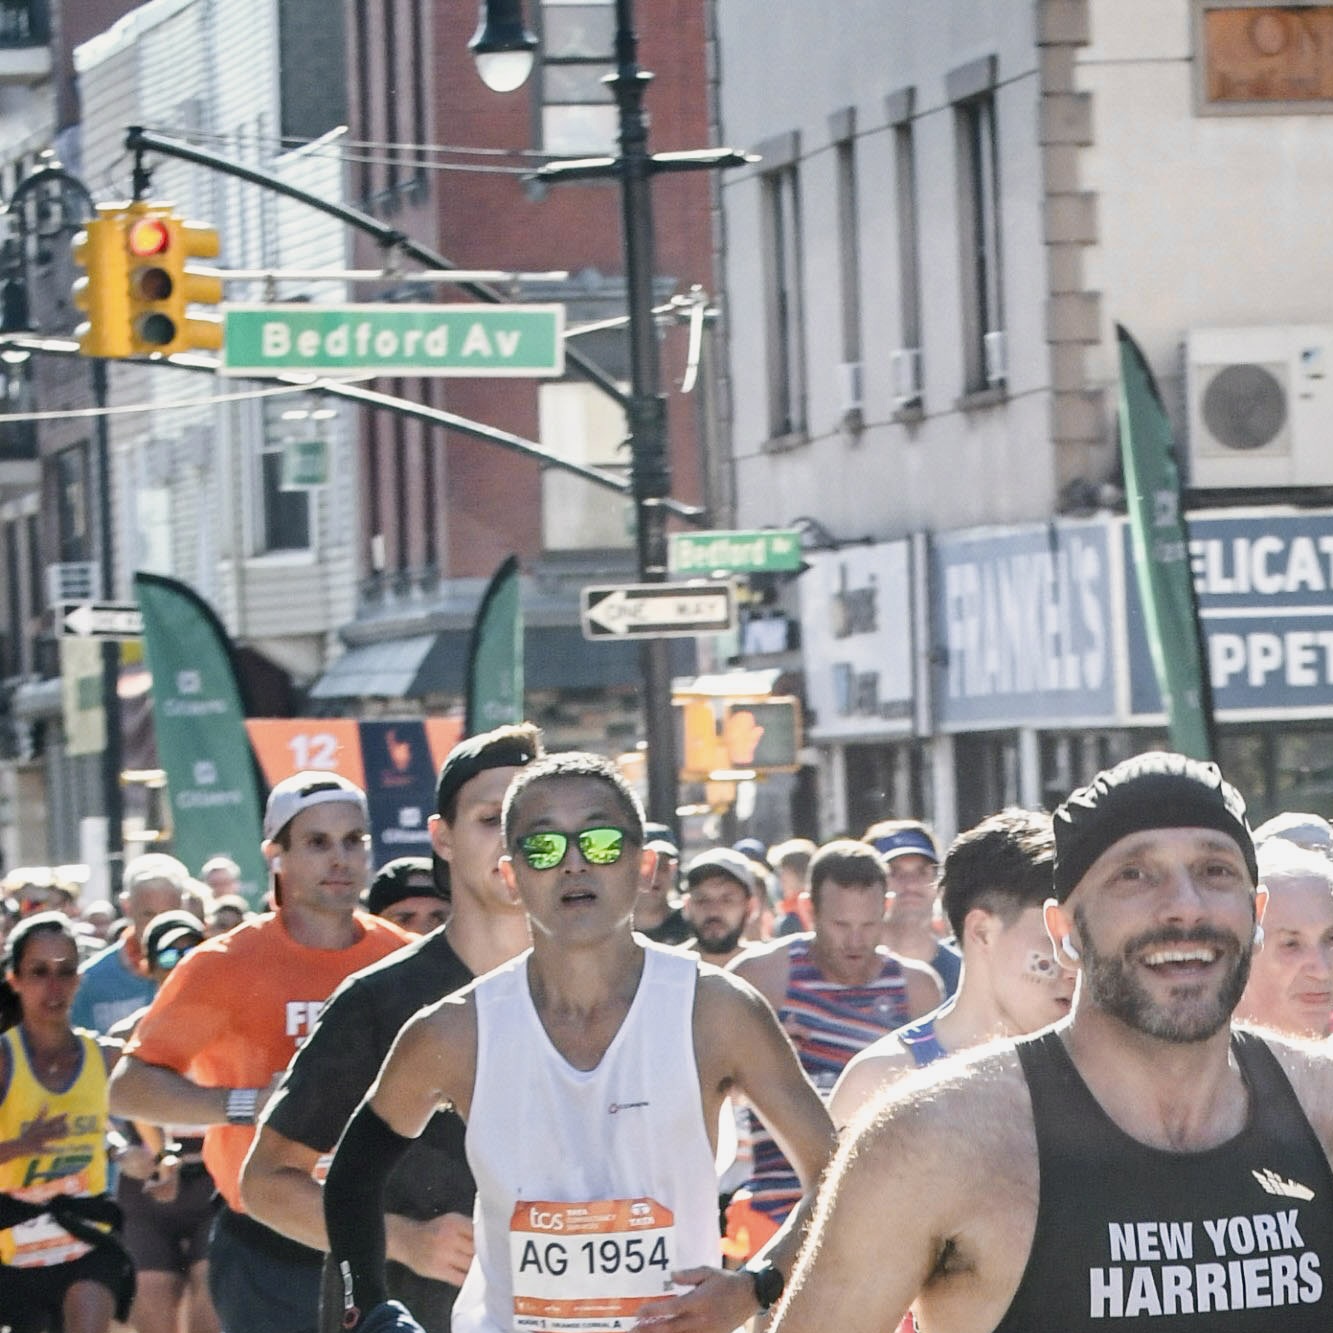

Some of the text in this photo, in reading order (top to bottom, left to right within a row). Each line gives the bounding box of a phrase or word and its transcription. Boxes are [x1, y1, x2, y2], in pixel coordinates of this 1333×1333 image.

[262, 321, 522, 358] Bedford Av
[678, 538, 767, 567] Bedford
[606, 600, 719, 622] ONE WAY
[287, 733, 339, 771] 12
[529, 1206, 564, 1231] tcs
[1109, 1208, 1306, 1262] NEW YORK
[519, 1235, 670, 1277] AG 1954
[1089, 1251, 1324, 1319] HARRIERS
